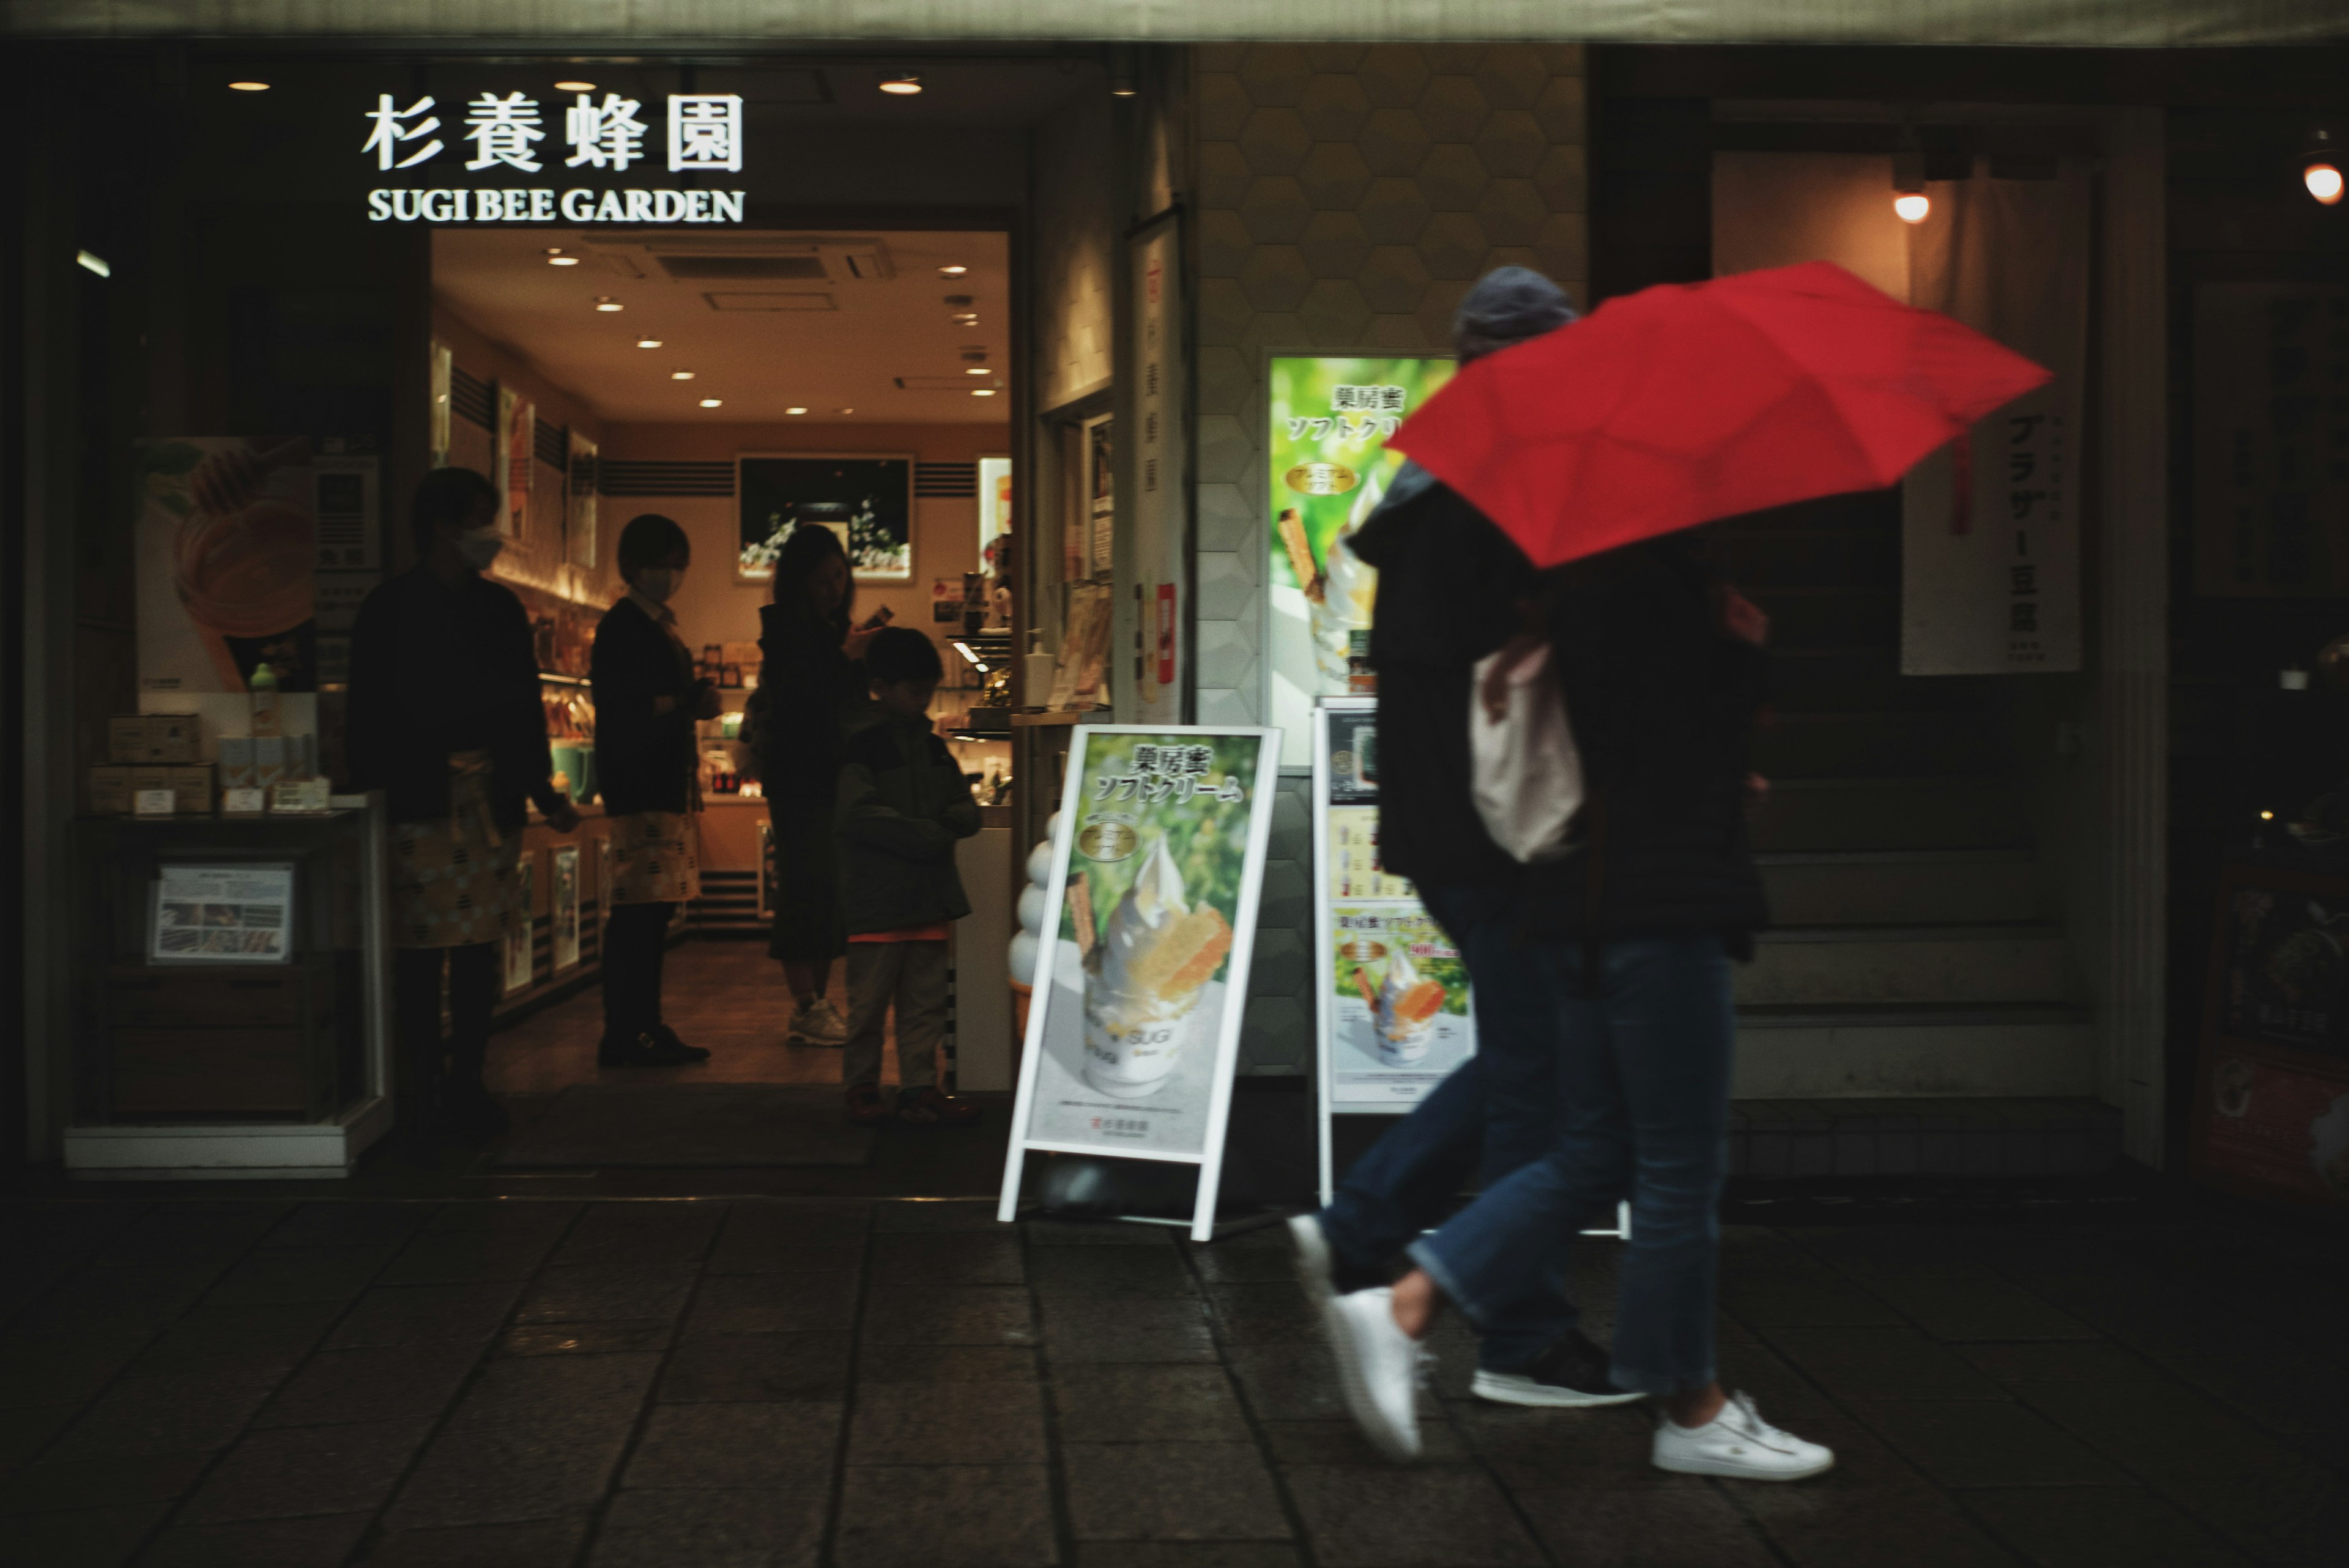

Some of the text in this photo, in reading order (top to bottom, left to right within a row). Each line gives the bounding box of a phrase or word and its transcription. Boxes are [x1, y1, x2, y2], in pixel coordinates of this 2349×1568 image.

[361, 91, 743, 172] 杉養蜂園
[367, 188, 746, 223] SUGI BEE GARDEN
[1095, 774, 1244, 805] ソフトクリーム
